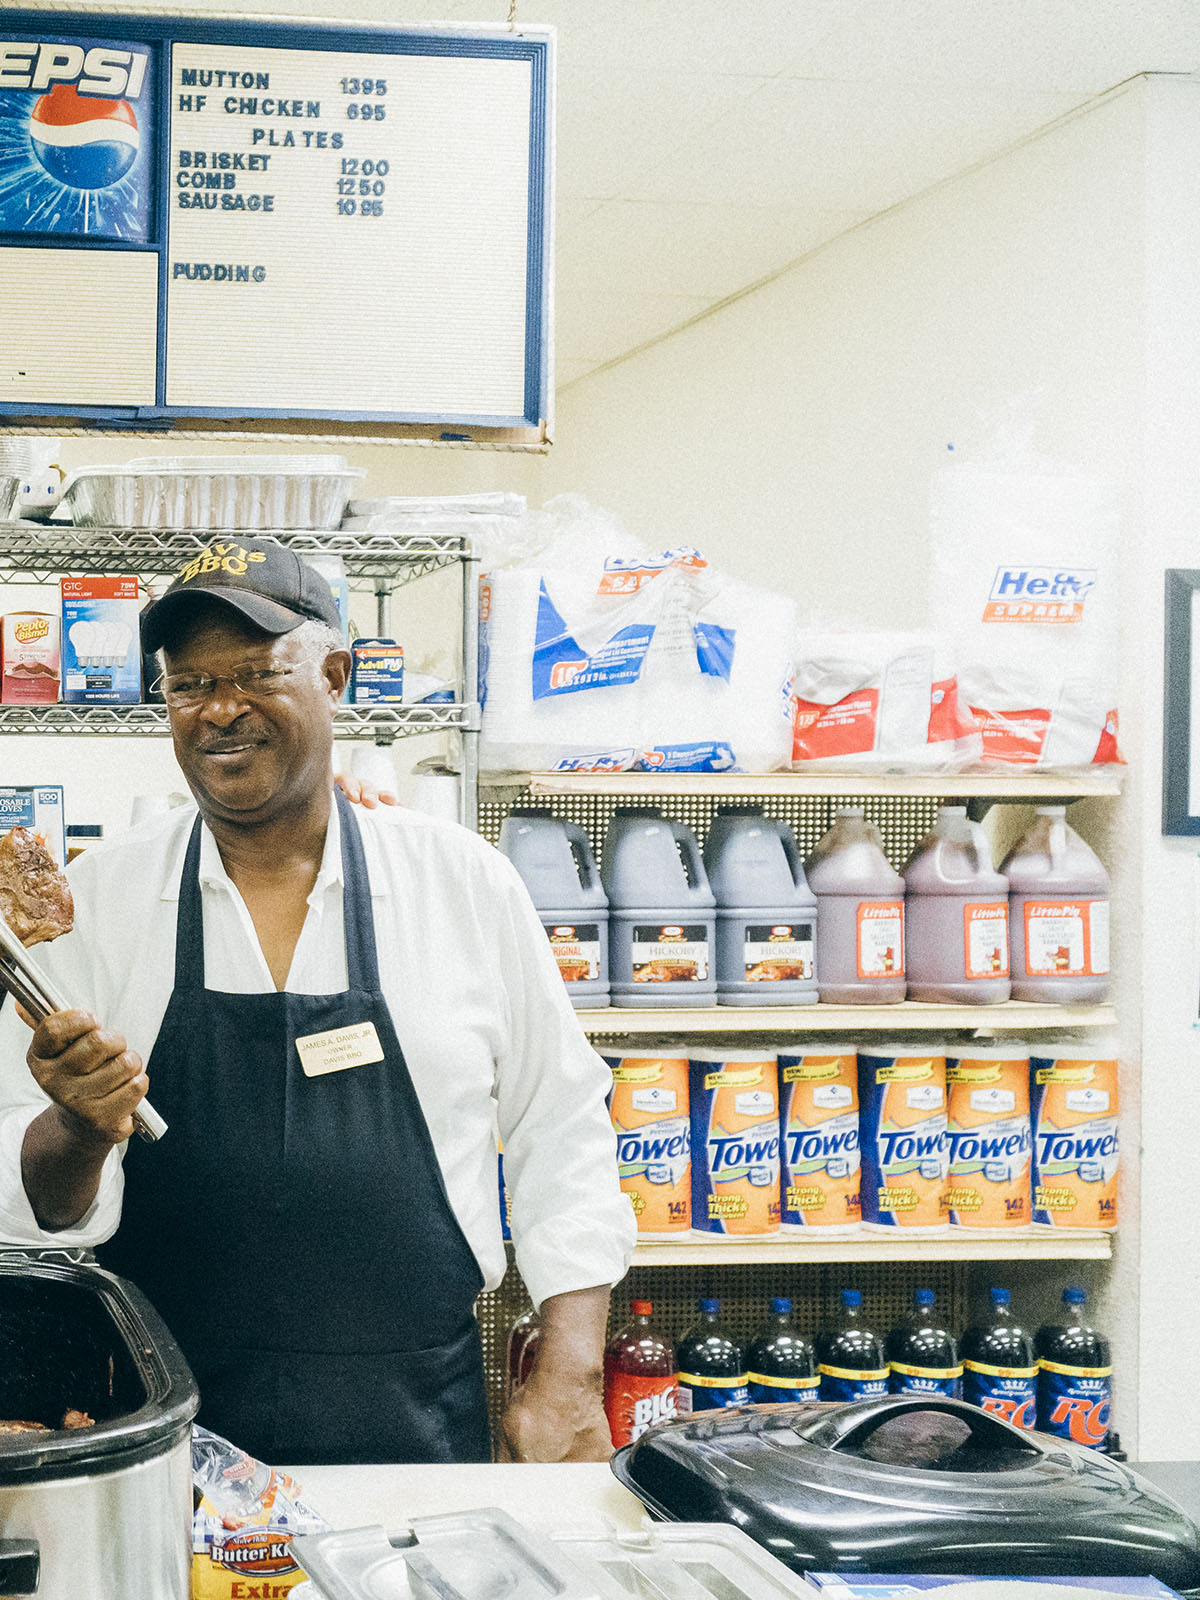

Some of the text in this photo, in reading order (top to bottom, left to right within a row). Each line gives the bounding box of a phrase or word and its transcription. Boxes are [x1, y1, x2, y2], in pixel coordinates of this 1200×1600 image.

[181, 68, 388, 96] MUTTON 1395
[179, 94, 386, 121] HF CHICKEN 695
[252, 128, 344, 150] PLATES
[179, 150, 390, 176] BRISKET 1200
[177, 171, 386, 197] COMB 1250
[177, 191, 275, 213] SAUSAGE
[173, 262, 267, 283] PUDDING
[182, 556, 248, 583] BBQ
[19, 629, 49, 641] Bismol
[552, 946, 584, 956] RIGINAL
[302, 1040, 327, 1051] JAMES
[635, 1386, 674, 1426] BIG
[1050, 1396, 1111, 1446] RC
[211, 1544, 268, 1563] Butter
